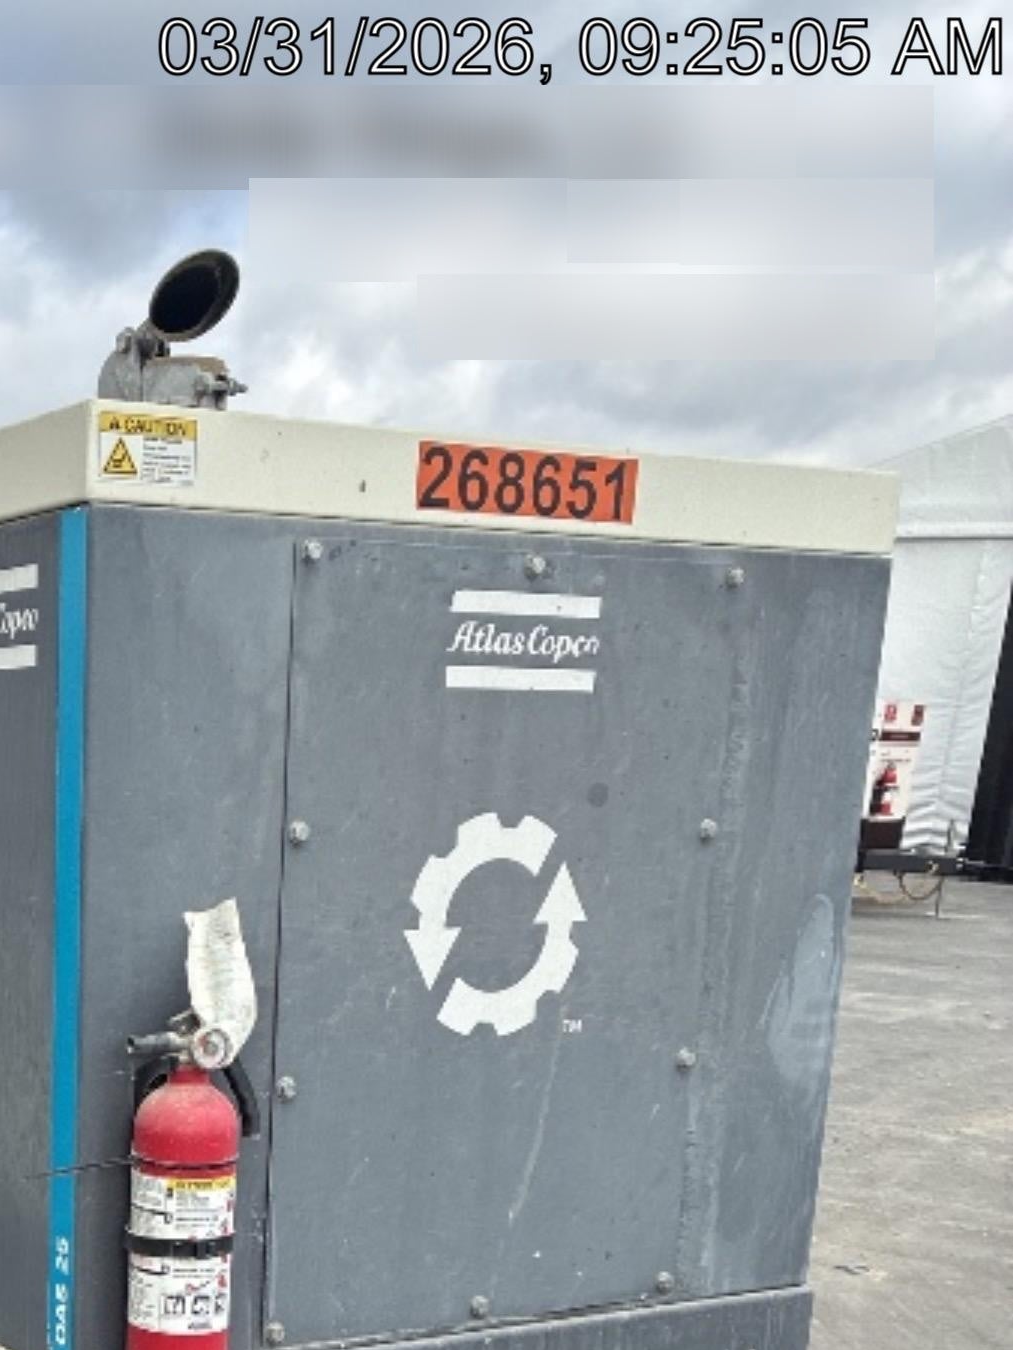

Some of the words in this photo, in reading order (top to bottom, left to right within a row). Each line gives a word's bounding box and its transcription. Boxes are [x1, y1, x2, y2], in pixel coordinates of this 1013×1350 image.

[419, 446, 626, 521] 268651
[446, 620, 525, 655] Atlas
[527, 624, 600, 664] Copco
